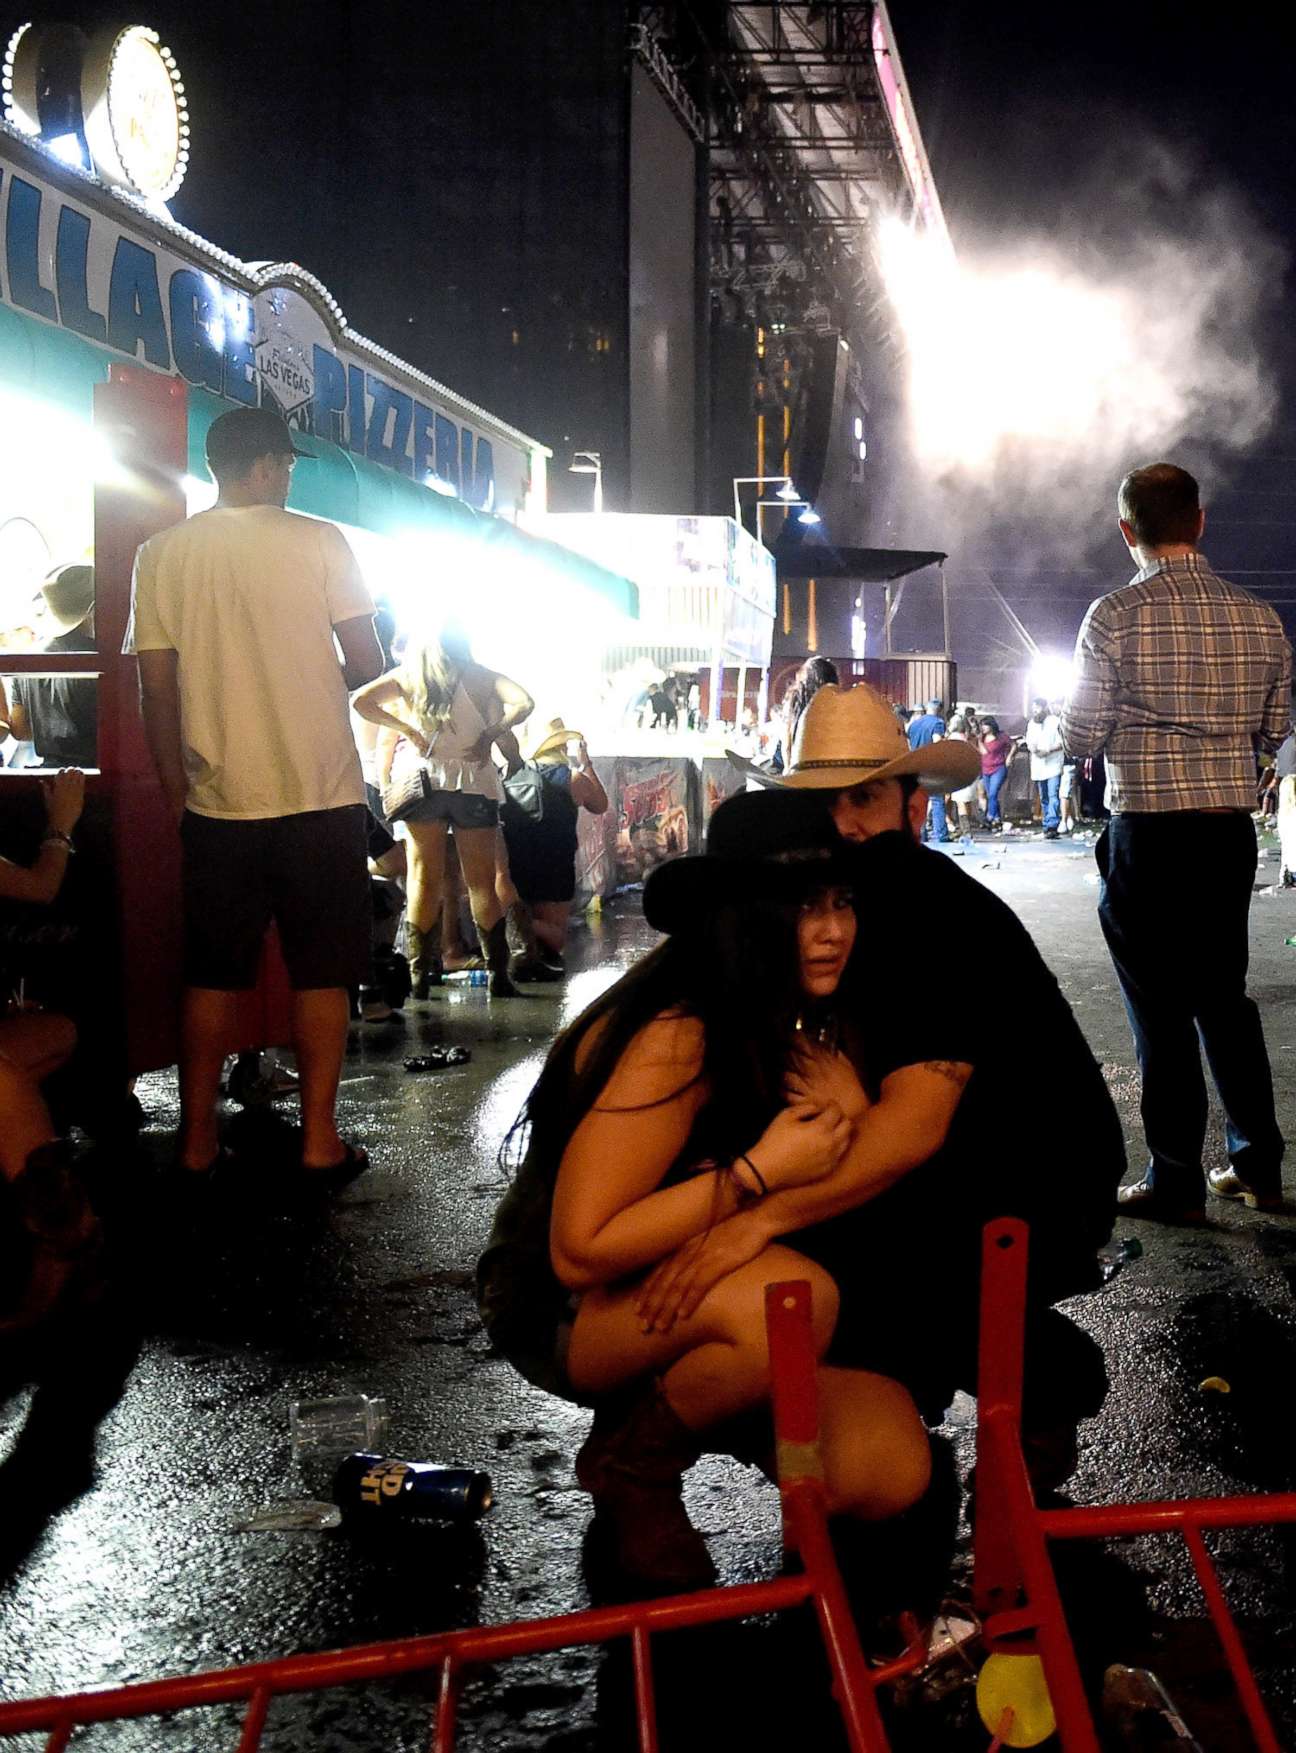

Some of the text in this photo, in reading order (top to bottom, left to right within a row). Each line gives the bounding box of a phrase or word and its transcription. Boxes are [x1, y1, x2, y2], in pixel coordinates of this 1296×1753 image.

[0, 168, 495, 511] LLAGE PIZZERIA
[260, 355, 279, 379] LAS
[281, 366, 311, 395] VEGAS
